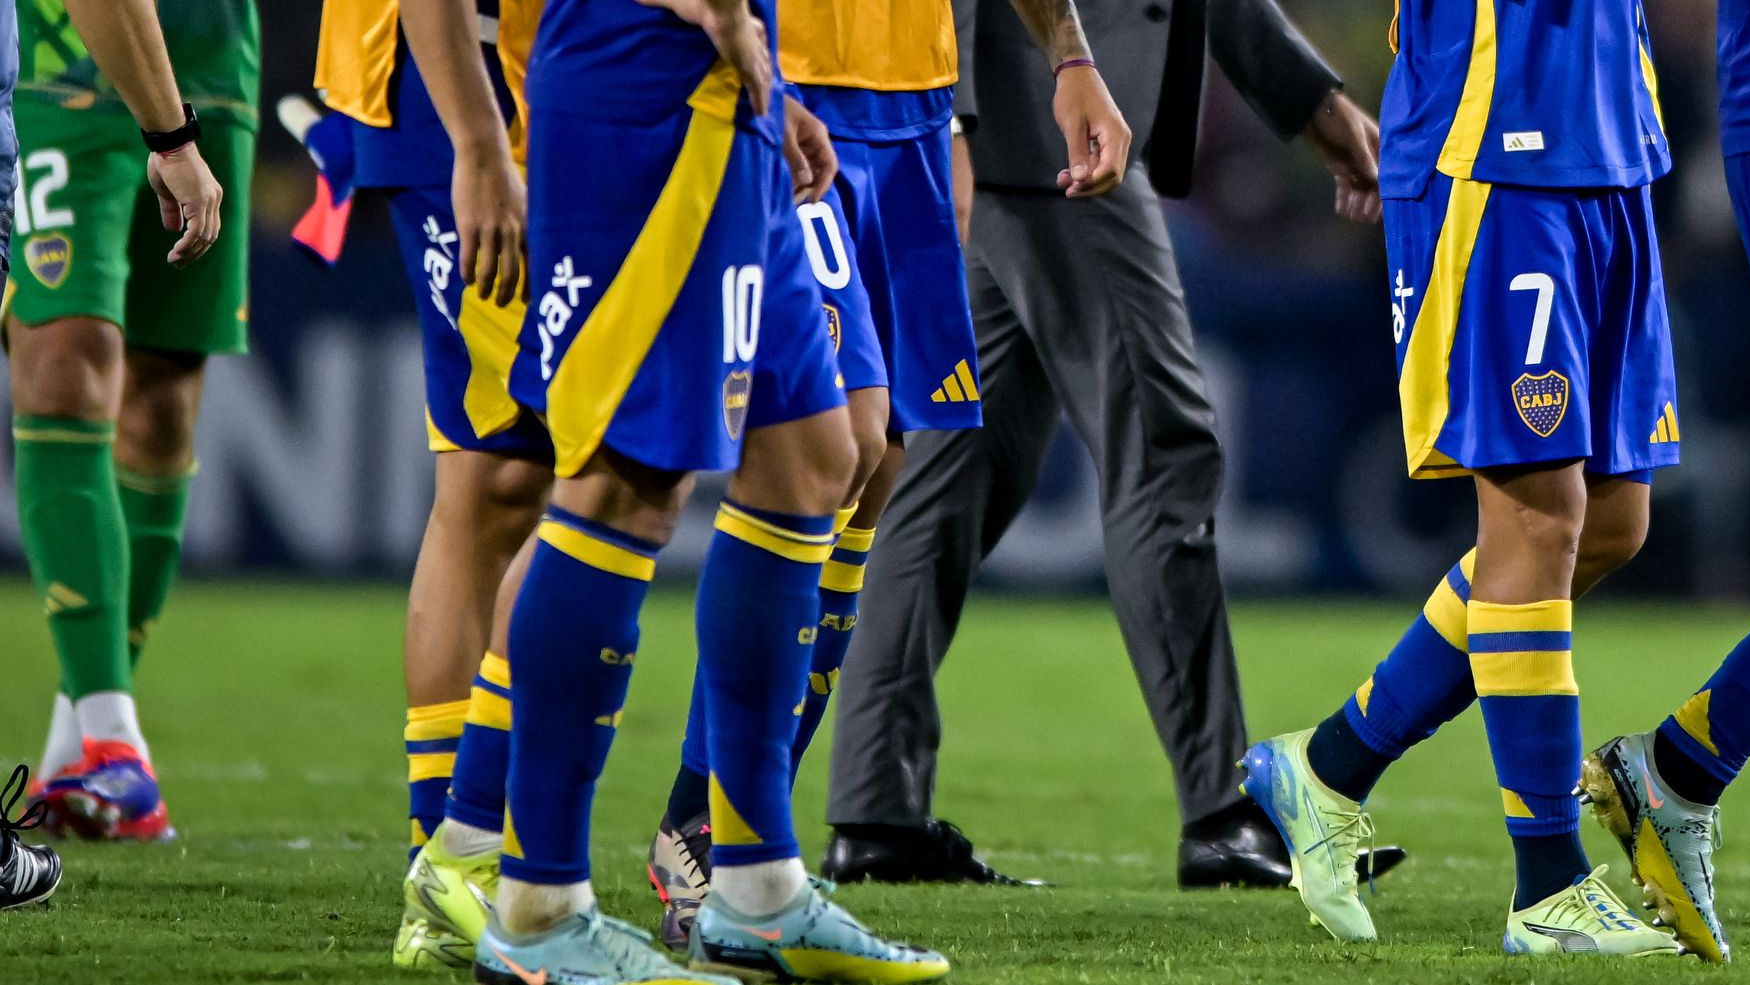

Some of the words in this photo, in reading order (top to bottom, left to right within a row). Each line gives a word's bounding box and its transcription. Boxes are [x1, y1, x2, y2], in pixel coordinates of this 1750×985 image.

[14, 147, 75, 236] 12
[796, 200, 851, 290] 0
[721, 264, 764, 364] 10
[1509, 272, 1555, 366] 7
[1520, 392, 1563, 409] CABJ
